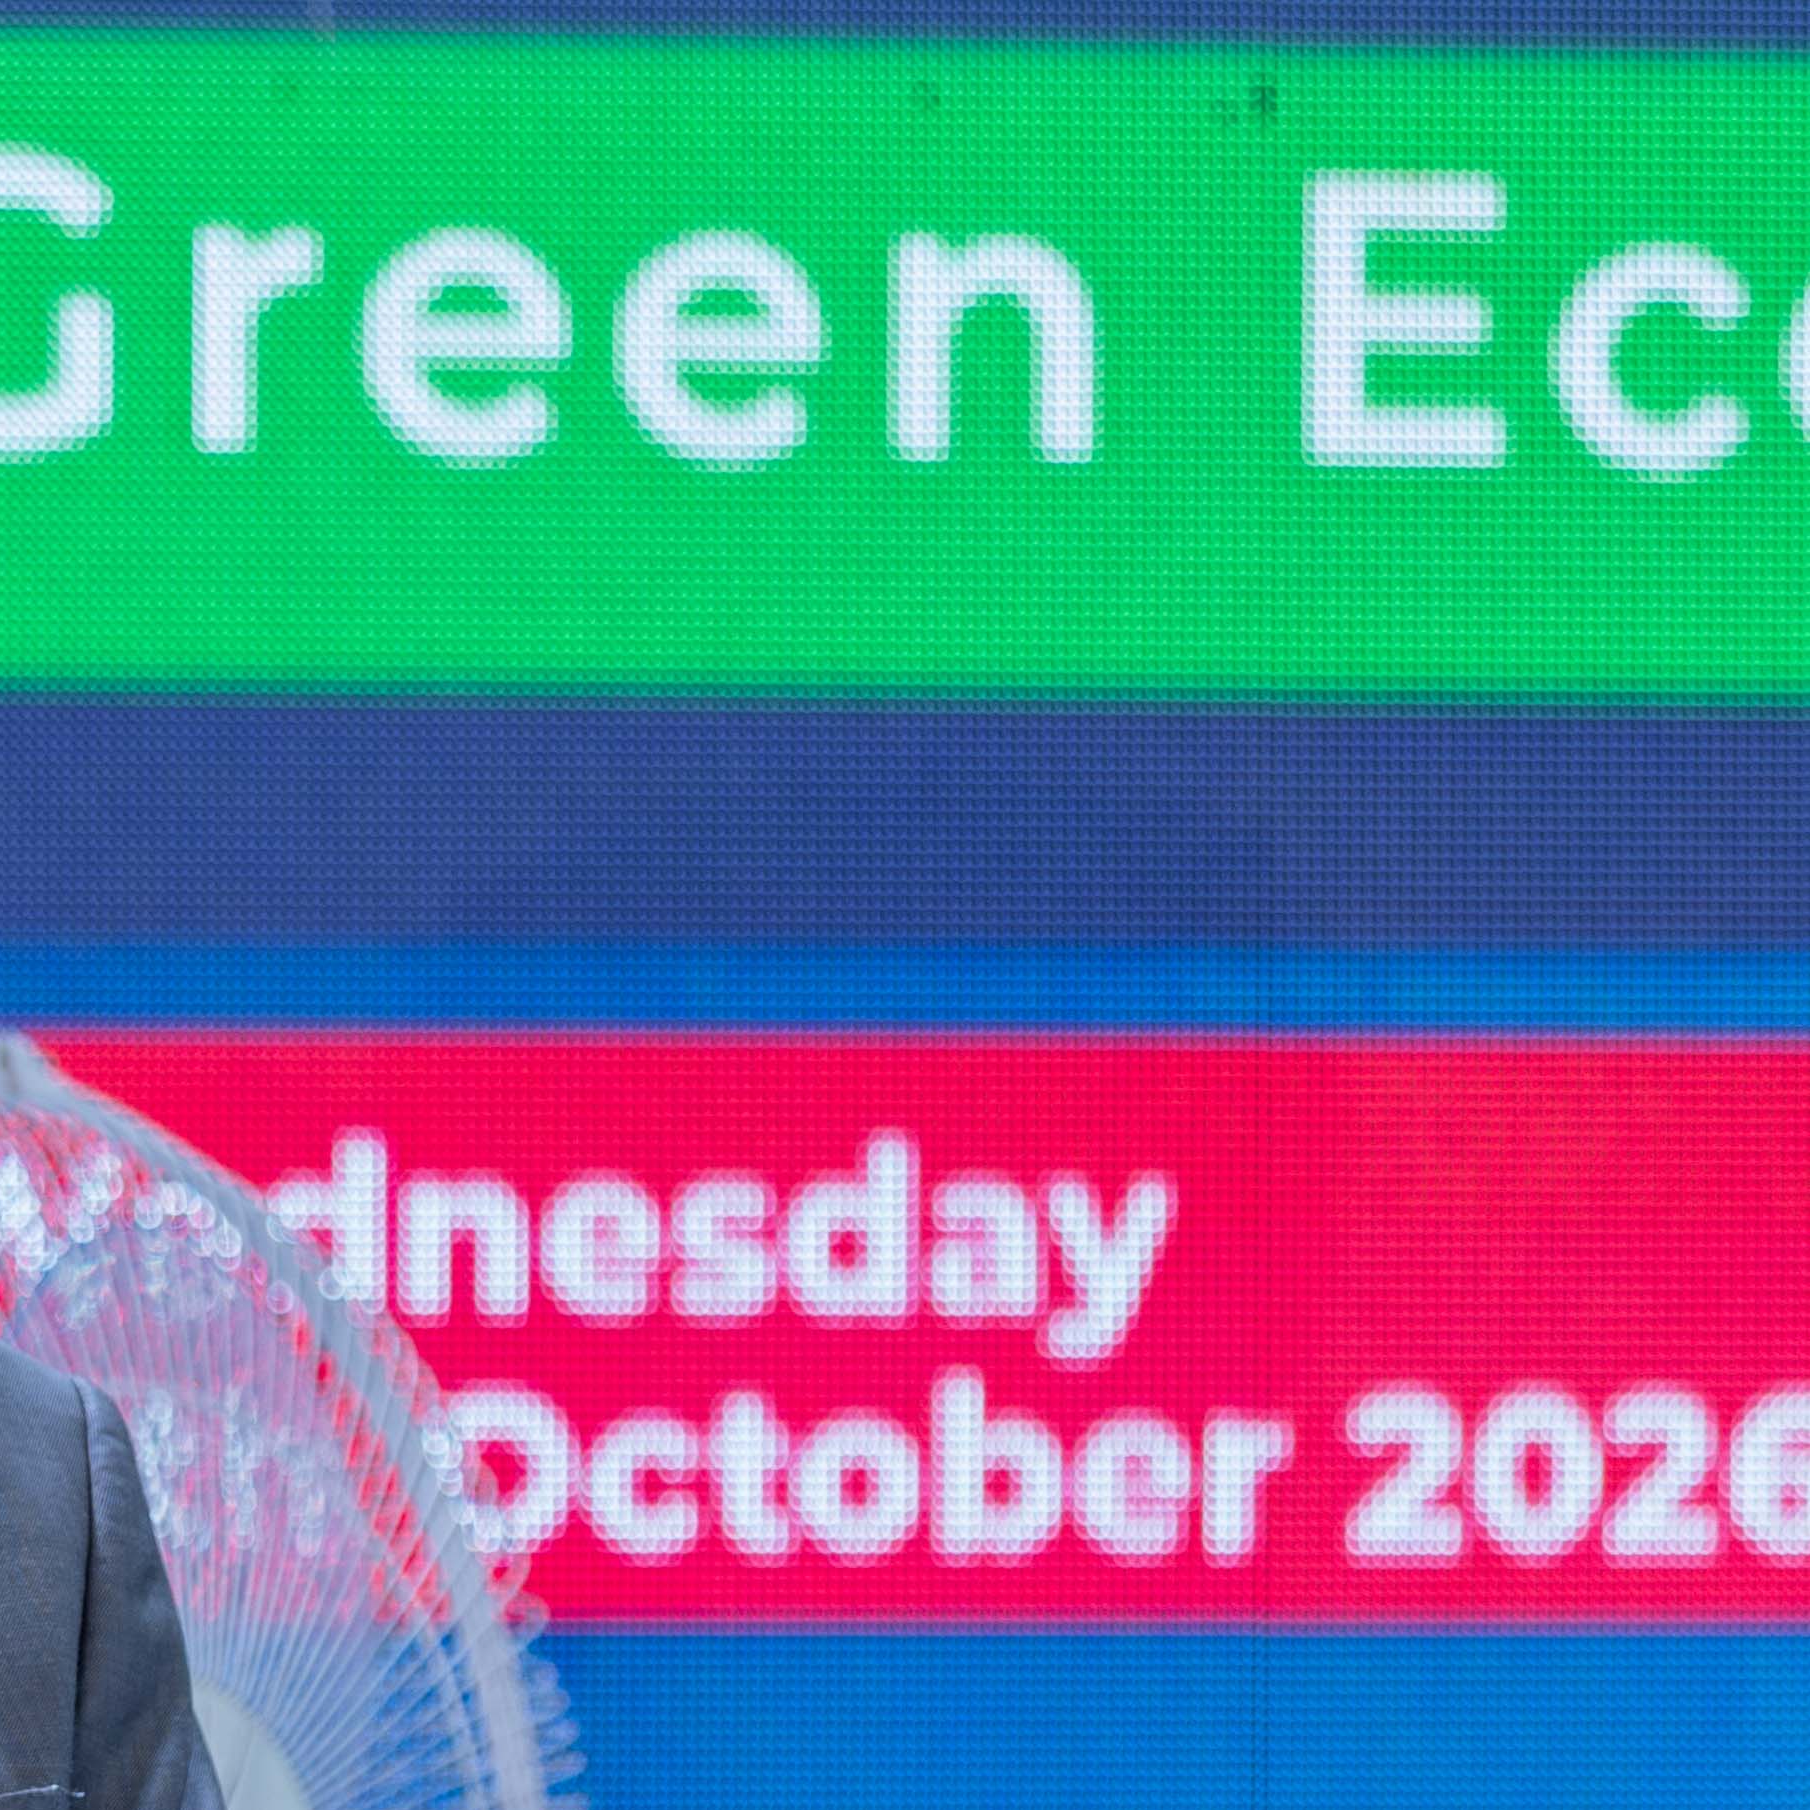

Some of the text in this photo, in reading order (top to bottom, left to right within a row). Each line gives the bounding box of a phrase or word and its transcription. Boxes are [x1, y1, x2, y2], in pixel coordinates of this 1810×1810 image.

[1301, 166, 1810, 482] Ec
[421, 1362, 1295, 1567] October
[1343, 1378, 1810, 1569] 2026
